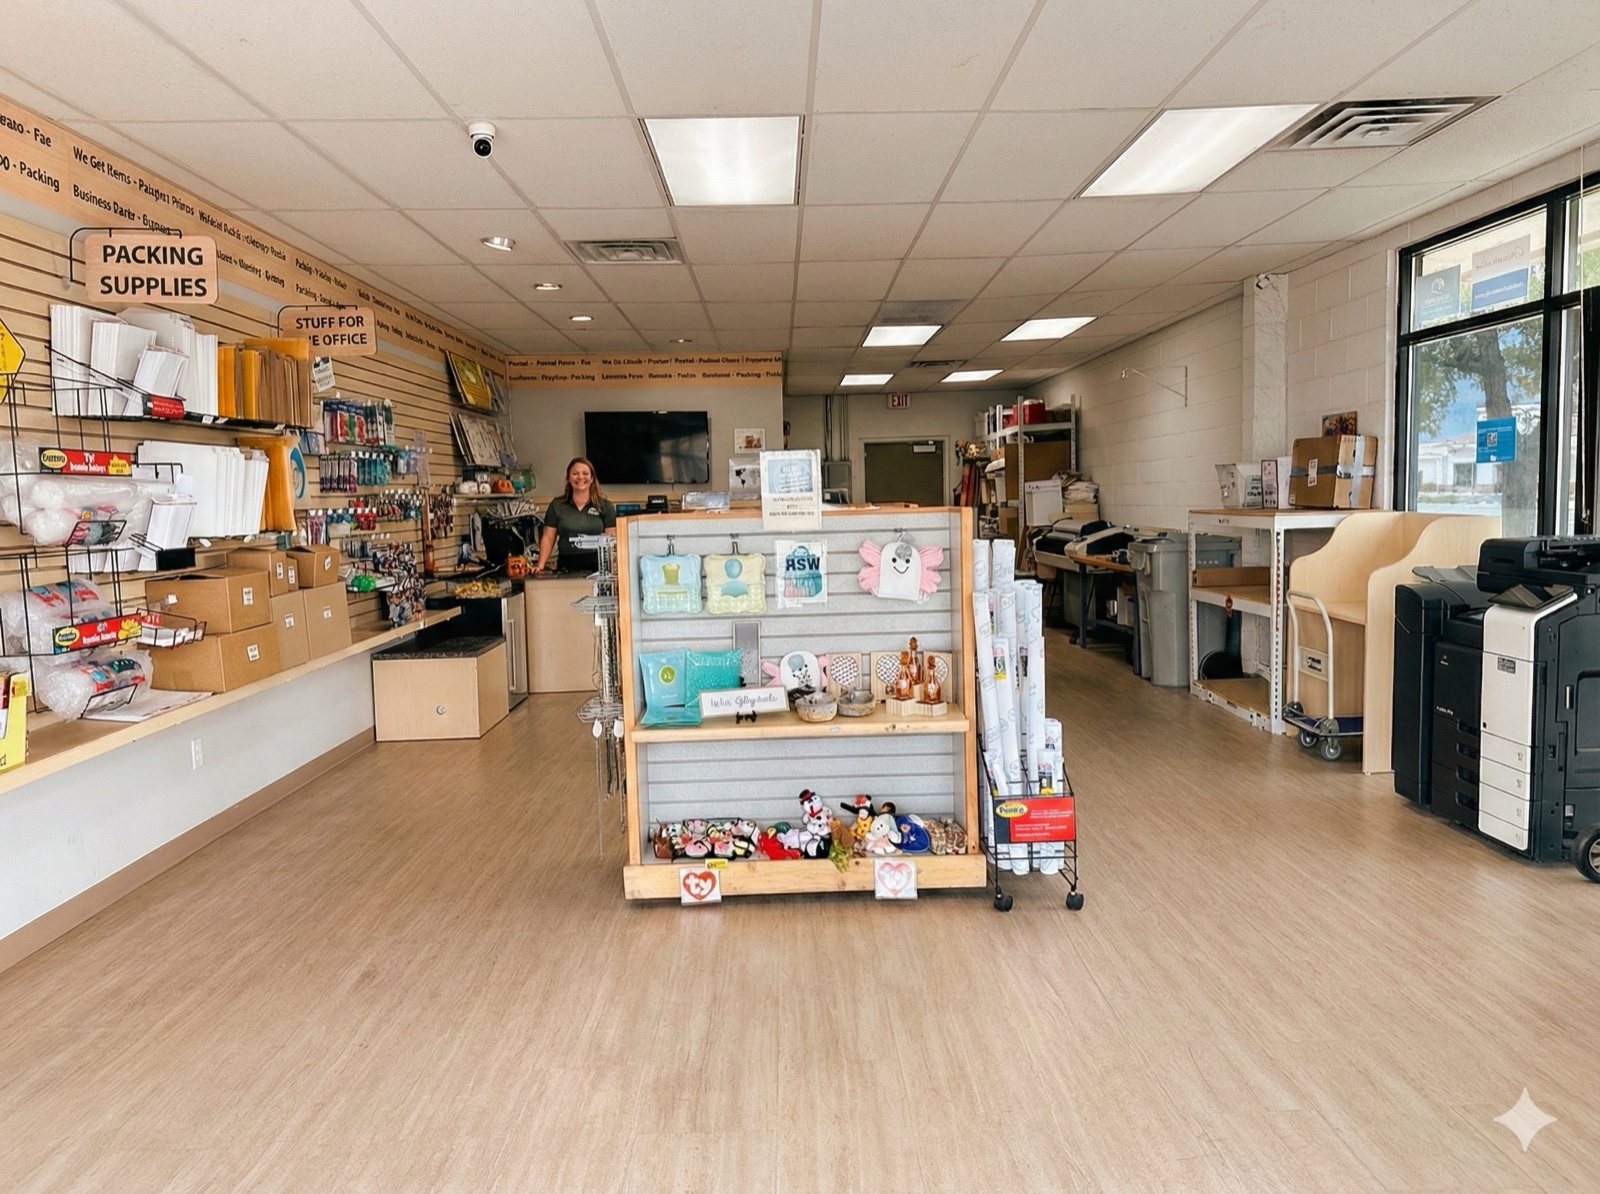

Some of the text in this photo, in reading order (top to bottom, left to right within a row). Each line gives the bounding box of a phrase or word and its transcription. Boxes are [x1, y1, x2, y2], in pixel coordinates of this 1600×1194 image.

[90, 156, 105, 173] Get
[20, 161, 60, 193] Packing
[73, 184, 112, 211] Business
[103, 245, 203, 265] PACKING
[100, 276, 208, 297] SUPPLIES
[296, 315, 364, 329] STUFF FOR
[322, 333, 367, 346] OFFICE
[891, 394, 909, 407] EXIT
[684, 874, 713, 897] ty
